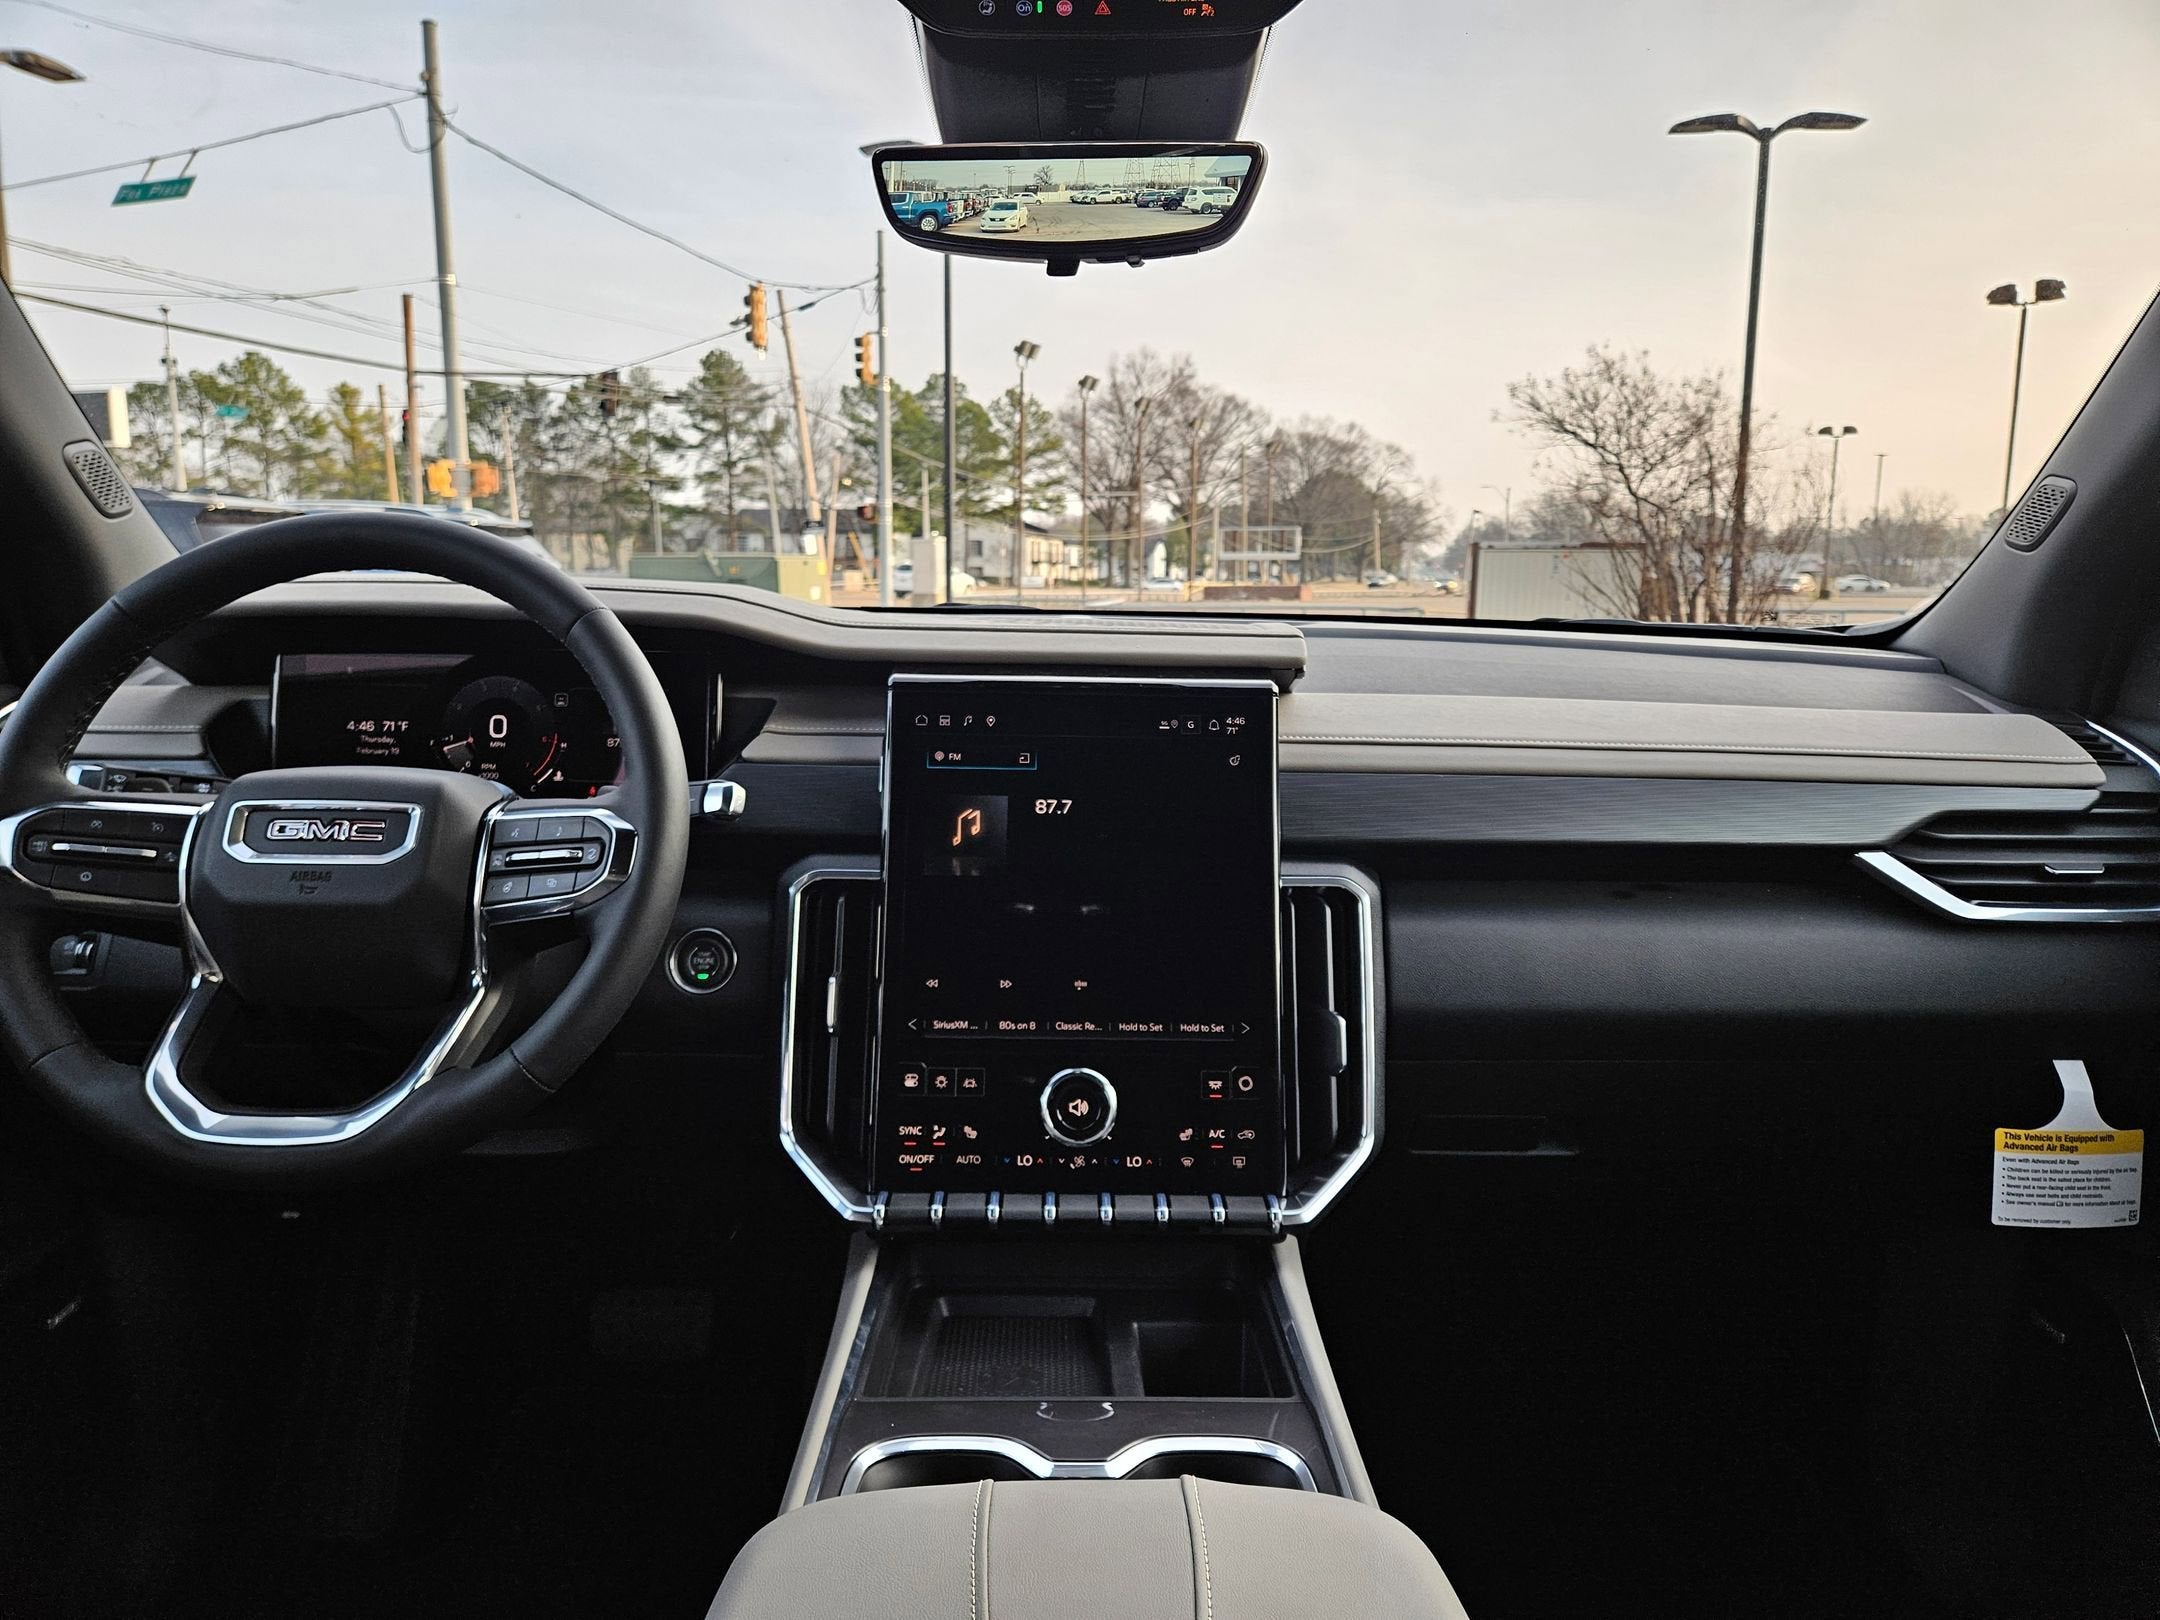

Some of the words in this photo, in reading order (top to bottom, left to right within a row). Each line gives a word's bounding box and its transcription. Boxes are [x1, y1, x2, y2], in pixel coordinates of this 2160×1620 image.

[1058, 4, 1071, 12] SOS
[1183, 8, 1197, 16] OFF
[489, 714, 508, 738] 0
[1226, 717, 1246, 725] 4:46
[346, 721, 375, 732] 4:46
[361, 735, 397, 745] Thursday,
[490, 741, 506, 749] MPH
[355, 747, 389, 757] February
[948, 753, 962, 761] FM
[1035, 799, 1073, 815] 87.7
[266, 819, 385, 841] GMC
[290, 871, 332, 882] AIRBAG
[933, 1020, 969, 1030] SiriusXM
[999, 1021, 1016, 1030] 80s
[1017, 1022, 1028, 1030] on
[1055, 1021, 1084, 1031] Classic
[1119, 1022, 1138, 1032] Hold
[1139, 1023, 1148, 1032] to
[1149, 1022, 1163, 1032] Set
[1180, 1023, 1199, 1033] Hold
[1200, 1023, 1210, 1033] to
[1211, 1023, 1225, 1033] Set
[899, 1126, 922, 1136] SYNC
[1208, 1129, 1226, 1139] A/C
[2004, 1131, 2022, 1141] This
[2024, 1133, 2053, 1143] Vehicle
[2055, 1134, 2063, 1143] is
[2064, 1134, 2098, 1144] Equipped
[2099, 1134, 2115, 1143] with
[2003, 1142, 2044, 1152] Advanced
[2046, 1144, 2058, 1152] Air
[2059, 1144, 2079, 1153] Bags
[899, 1154, 935, 1165] ON/OFF
[956, 1154, 981, 1165] AUTO
[1017, 1155, 1033, 1166] LO
[1126, 1156, 1142, 1168] LO
